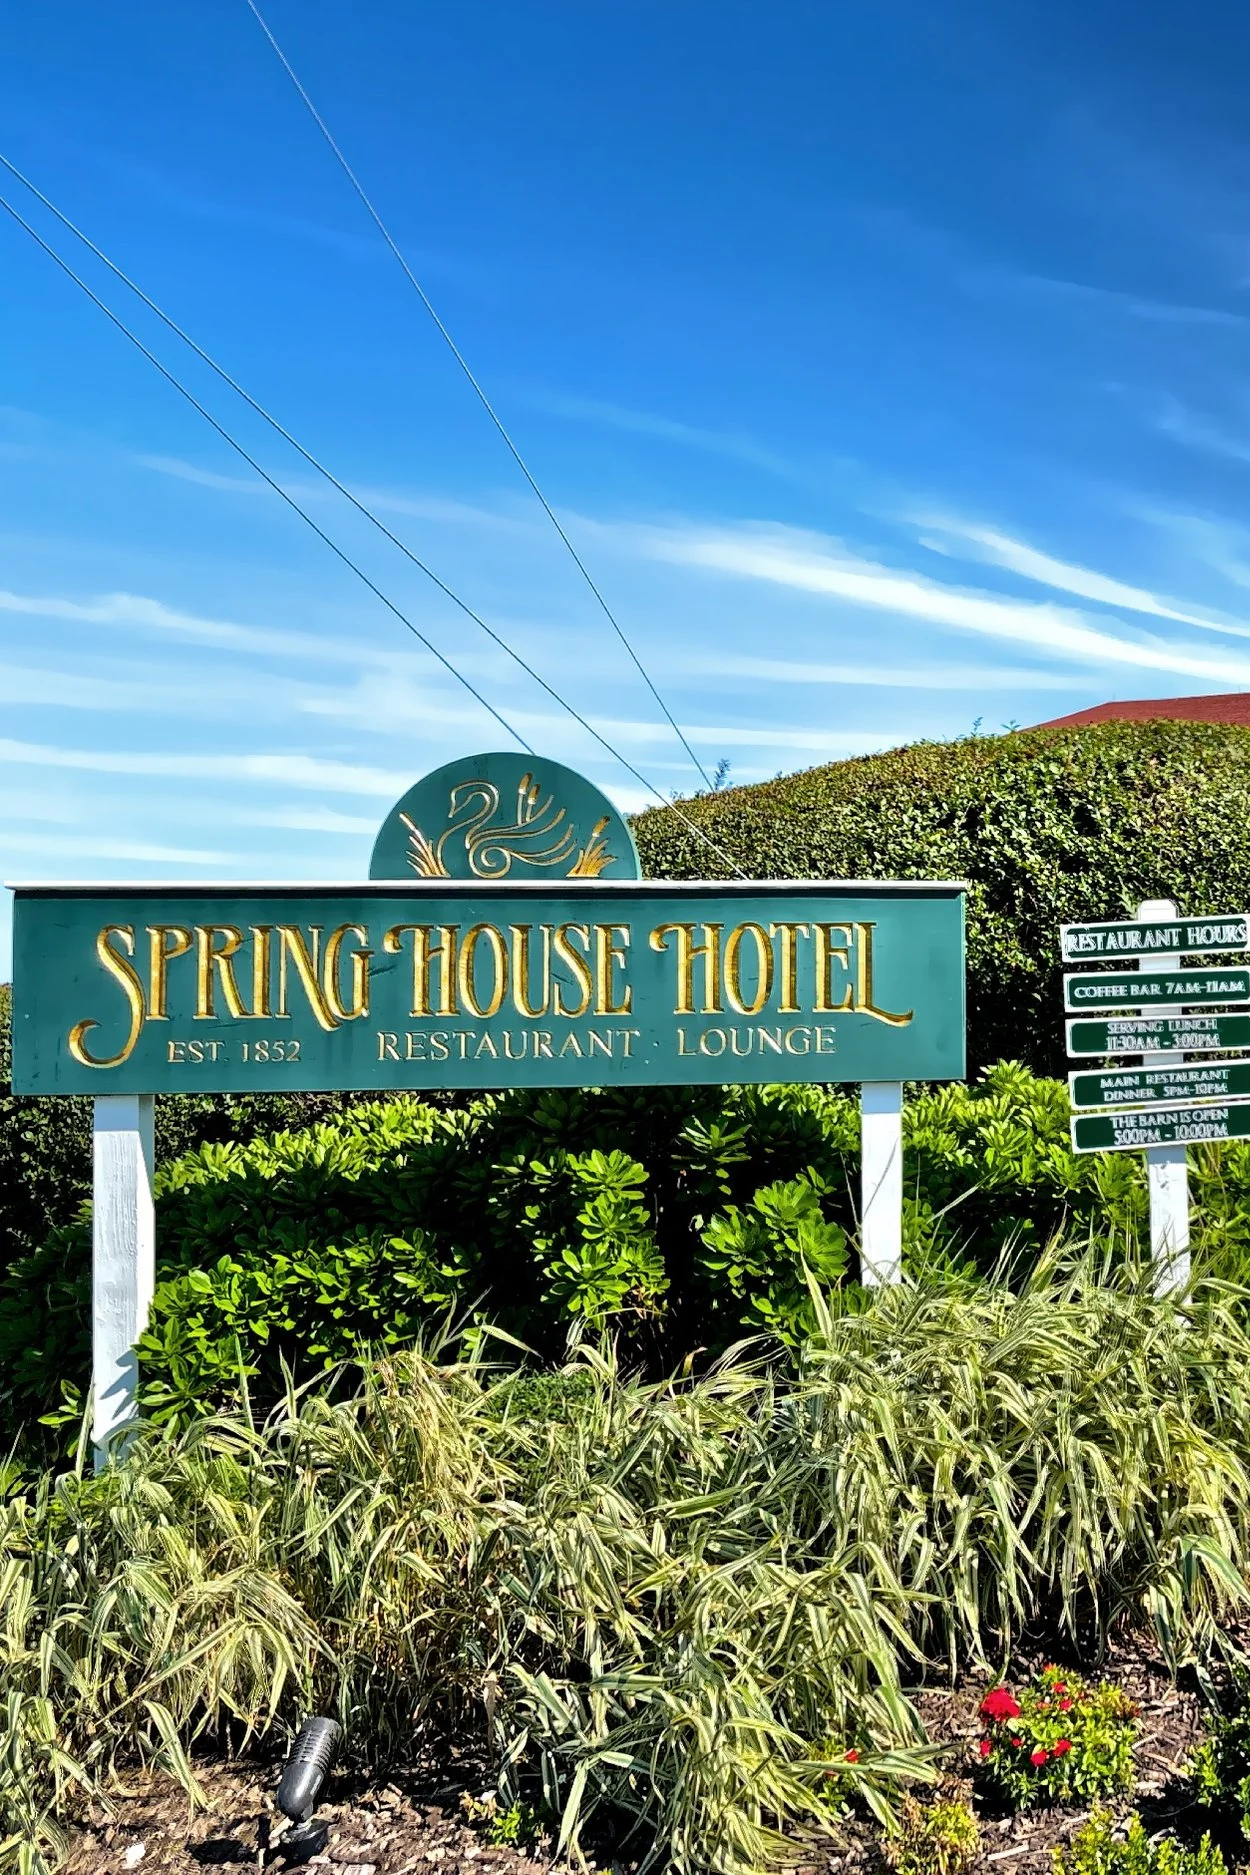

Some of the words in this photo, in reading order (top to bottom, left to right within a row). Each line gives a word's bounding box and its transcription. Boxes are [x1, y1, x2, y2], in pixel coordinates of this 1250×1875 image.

[1066, 928, 1182, 953] RESTAURANT
[1187, 923, 1248, 945] HOURS
[68, 922, 374, 1068] SPRING
[381, 921, 632, 1018] HOUSE
[648, 920, 914, 1028] HOTEL
[1074, 984, 1128, 998] COFFEE
[1130, 983, 1163, 996] BAR
[1107, 1020, 1164, 1034] SERVING
[1168, 1018, 1218, 1032] LUNCH
[241, 1039, 302, 1063] 1852
[376, 1028, 640, 1061] RESTAURANT
[676, 1025, 837, 1057] LOUNGE
[1100, 1075, 1140, 1088] MAIN
[1146, 1069, 1230, 1085] RESTAURANT
[1104, 1088, 1157, 1102] DINNER
[1109, 1115, 1138, 1129] THE
[1139, 1112, 1178, 1127] BARN
[1180, 1110, 1192, 1123] IS
[1192, 1108, 1229, 1122] OPEN
